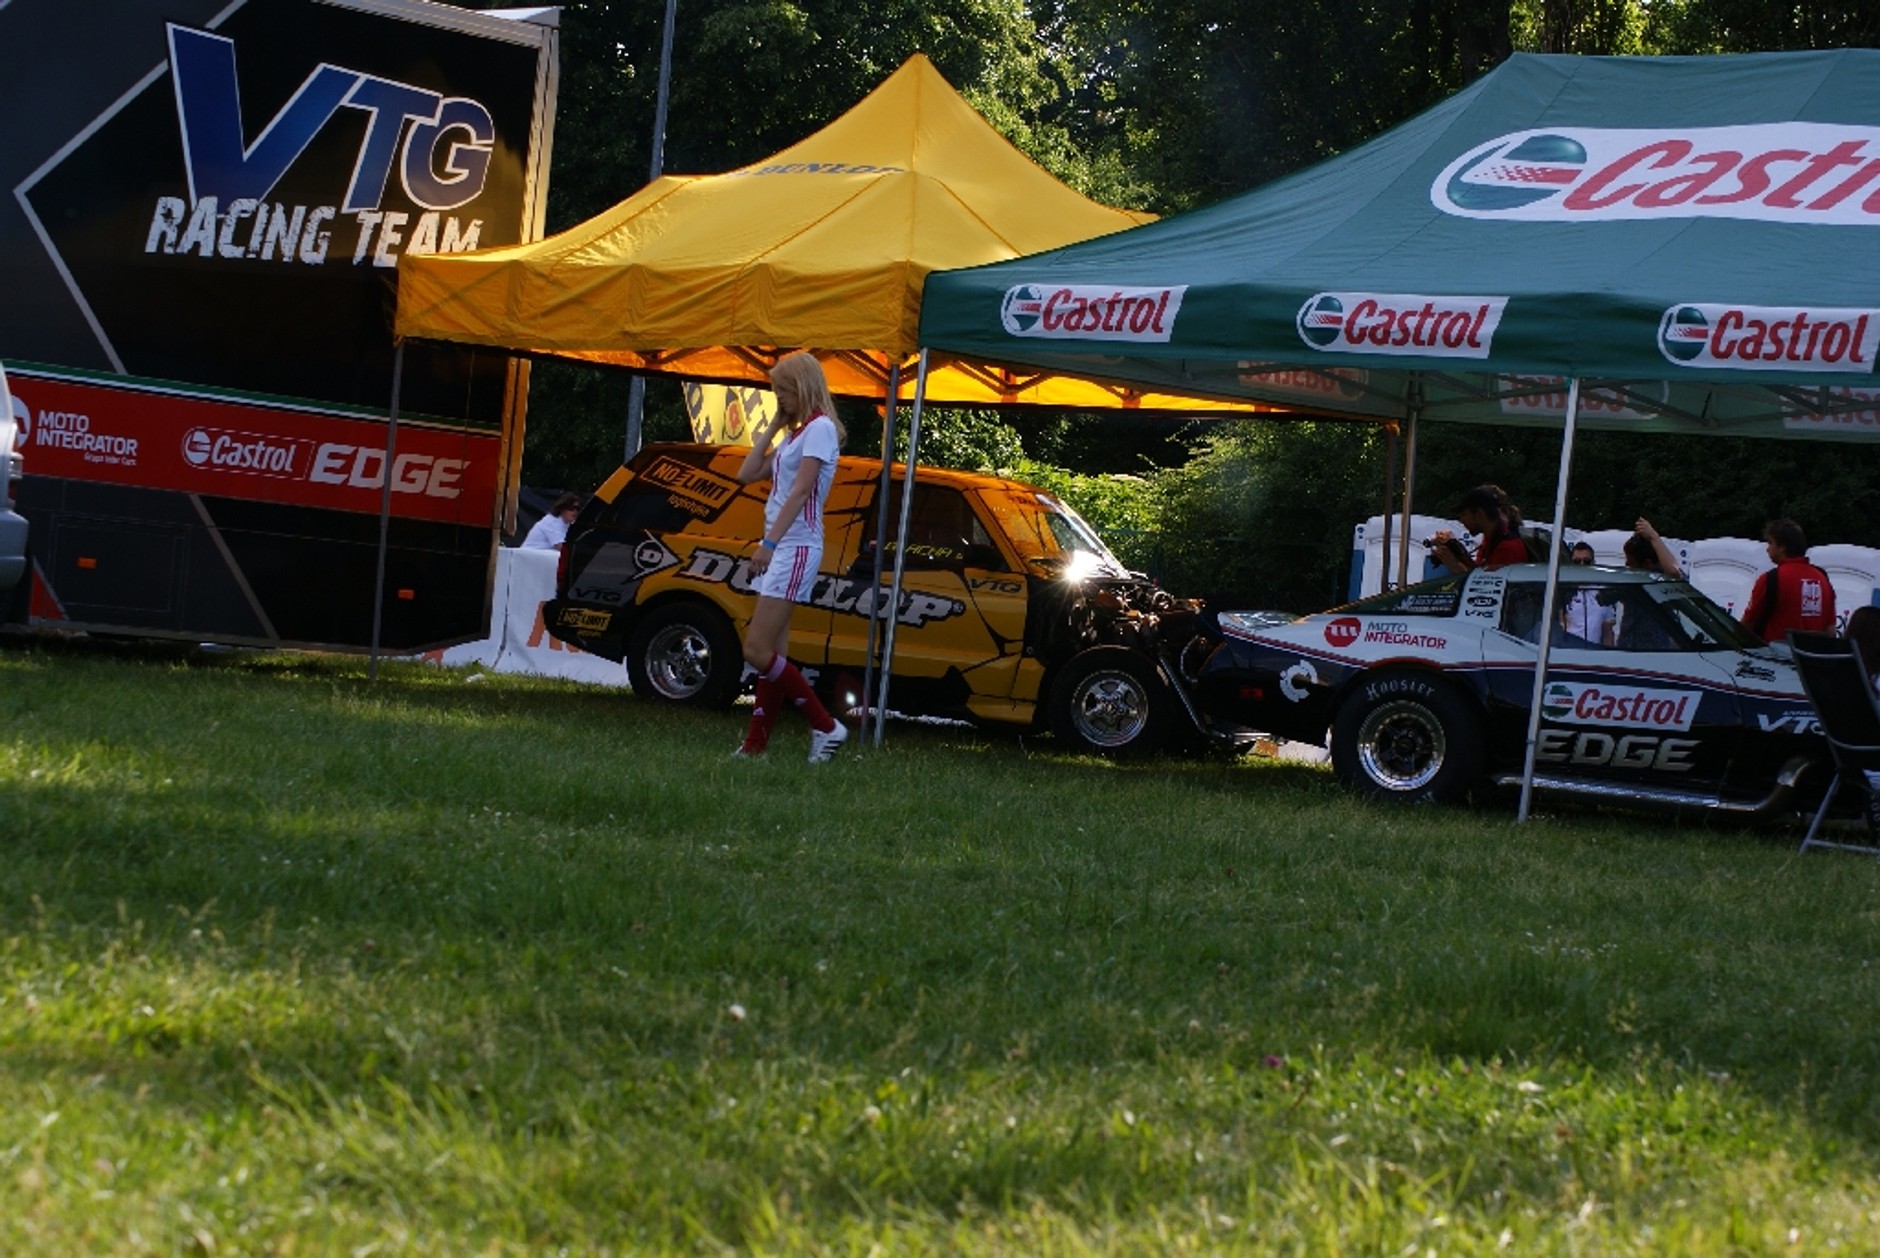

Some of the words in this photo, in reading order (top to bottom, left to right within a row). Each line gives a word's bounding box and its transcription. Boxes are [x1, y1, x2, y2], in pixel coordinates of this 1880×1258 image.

[165, 21, 495, 214] VTG
[1562, 138, 1880, 216] Castr
[145, 196, 337, 266] RACING
[352, 208, 483, 268] TEAM
[1042, 288, 1171, 334] Castrol
[1344, 299, 1491, 349] Castrol
[1710, 310, 1870, 363] Castrol
[36, 427, 138, 457] INTEGRATOR
[38, 410, 90, 433] MOTO
[211, 435, 295, 473] Castrol
[308, 442, 471, 498] EDGE
[653, 461, 681, 481] NO
[681, 474, 730, 502] LIMIT
[575, 586, 621, 602] VTG
[970, 579, 1022, 593] VTG
[1364, 632, 1447, 650] INTEGRATOR
[1367, 621, 1408, 633] MOTO
[1575, 688, 1690, 726] Castrol
[1535, 728, 1703, 772] EDGE
